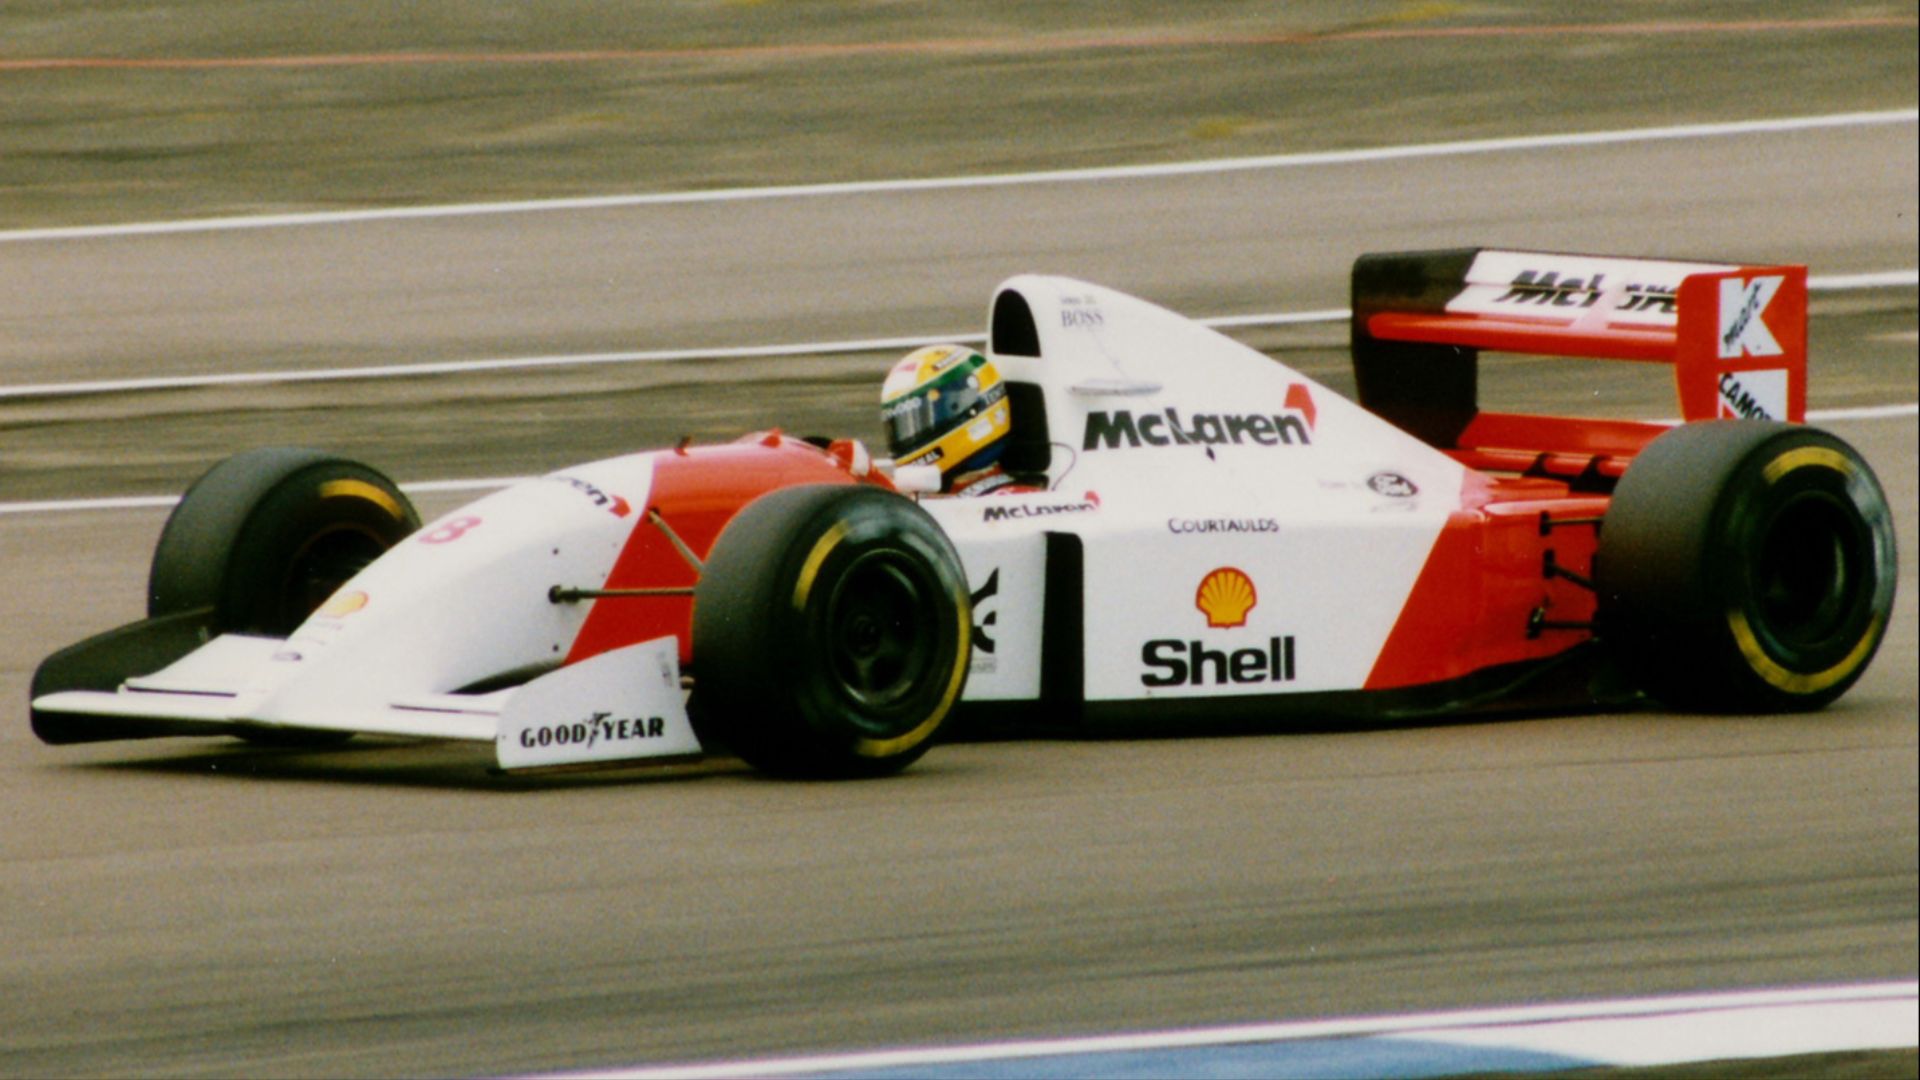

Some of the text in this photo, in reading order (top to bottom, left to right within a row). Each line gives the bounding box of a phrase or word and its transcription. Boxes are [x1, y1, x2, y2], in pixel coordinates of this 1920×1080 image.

[1082, 406, 1311, 452] McLaren
[984, 503, 1096, 522] McLaren
[1168, 517, 1280, 535] COURTAULDS
[418, 515, 483, 545] 8
[1140, 635, 1296, 688] Shell
[520, 716, 665, 749] GOOD YEAR
